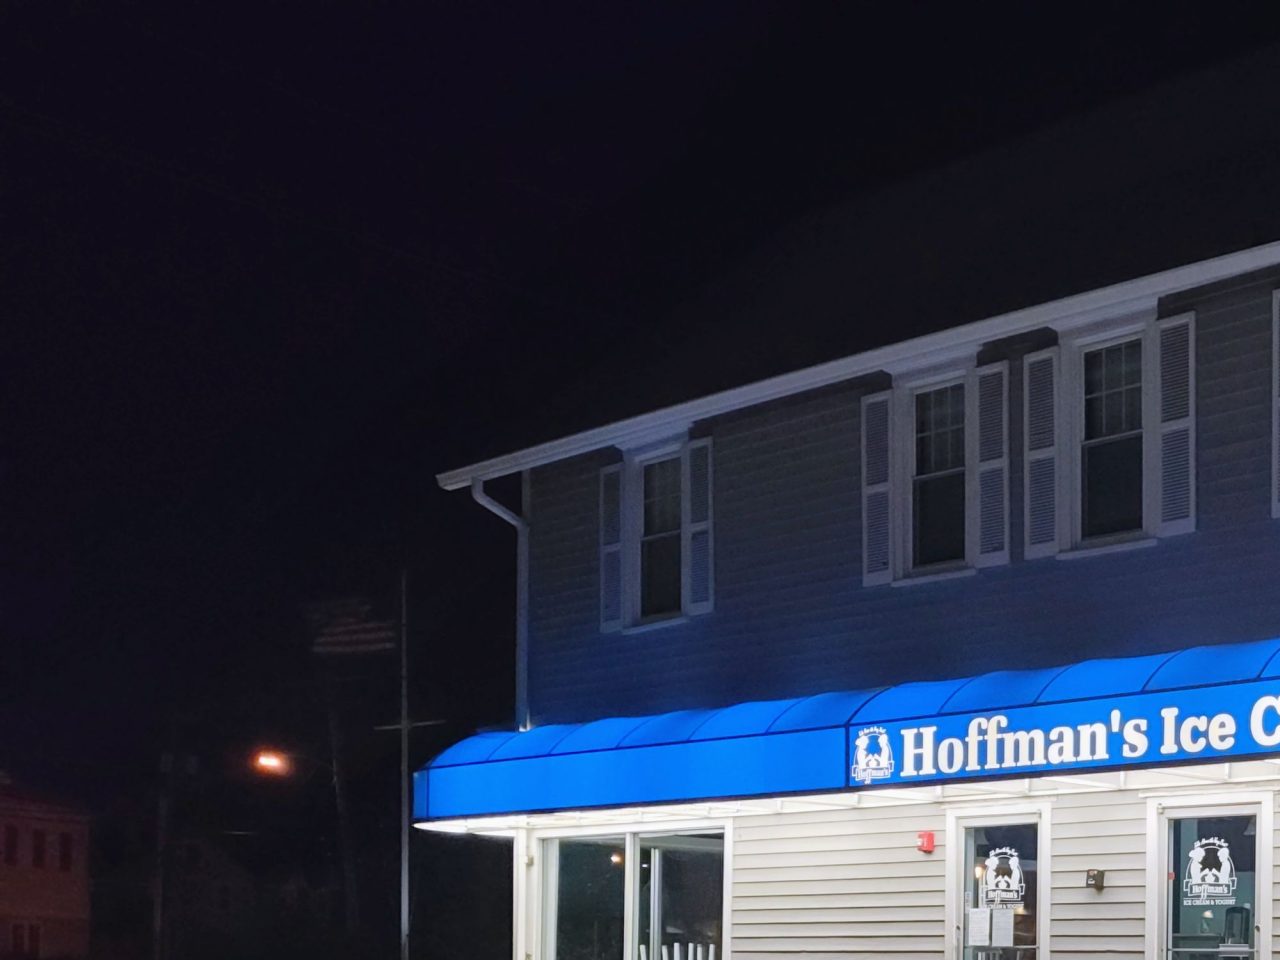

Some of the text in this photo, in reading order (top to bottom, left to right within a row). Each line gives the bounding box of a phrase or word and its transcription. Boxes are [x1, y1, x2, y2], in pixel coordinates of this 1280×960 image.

[900, 709, 1149, 777] Hoffman's
[1160, 705, 1237, 755] Ice
[1192, 884, 1228, 900] Hoffman's
